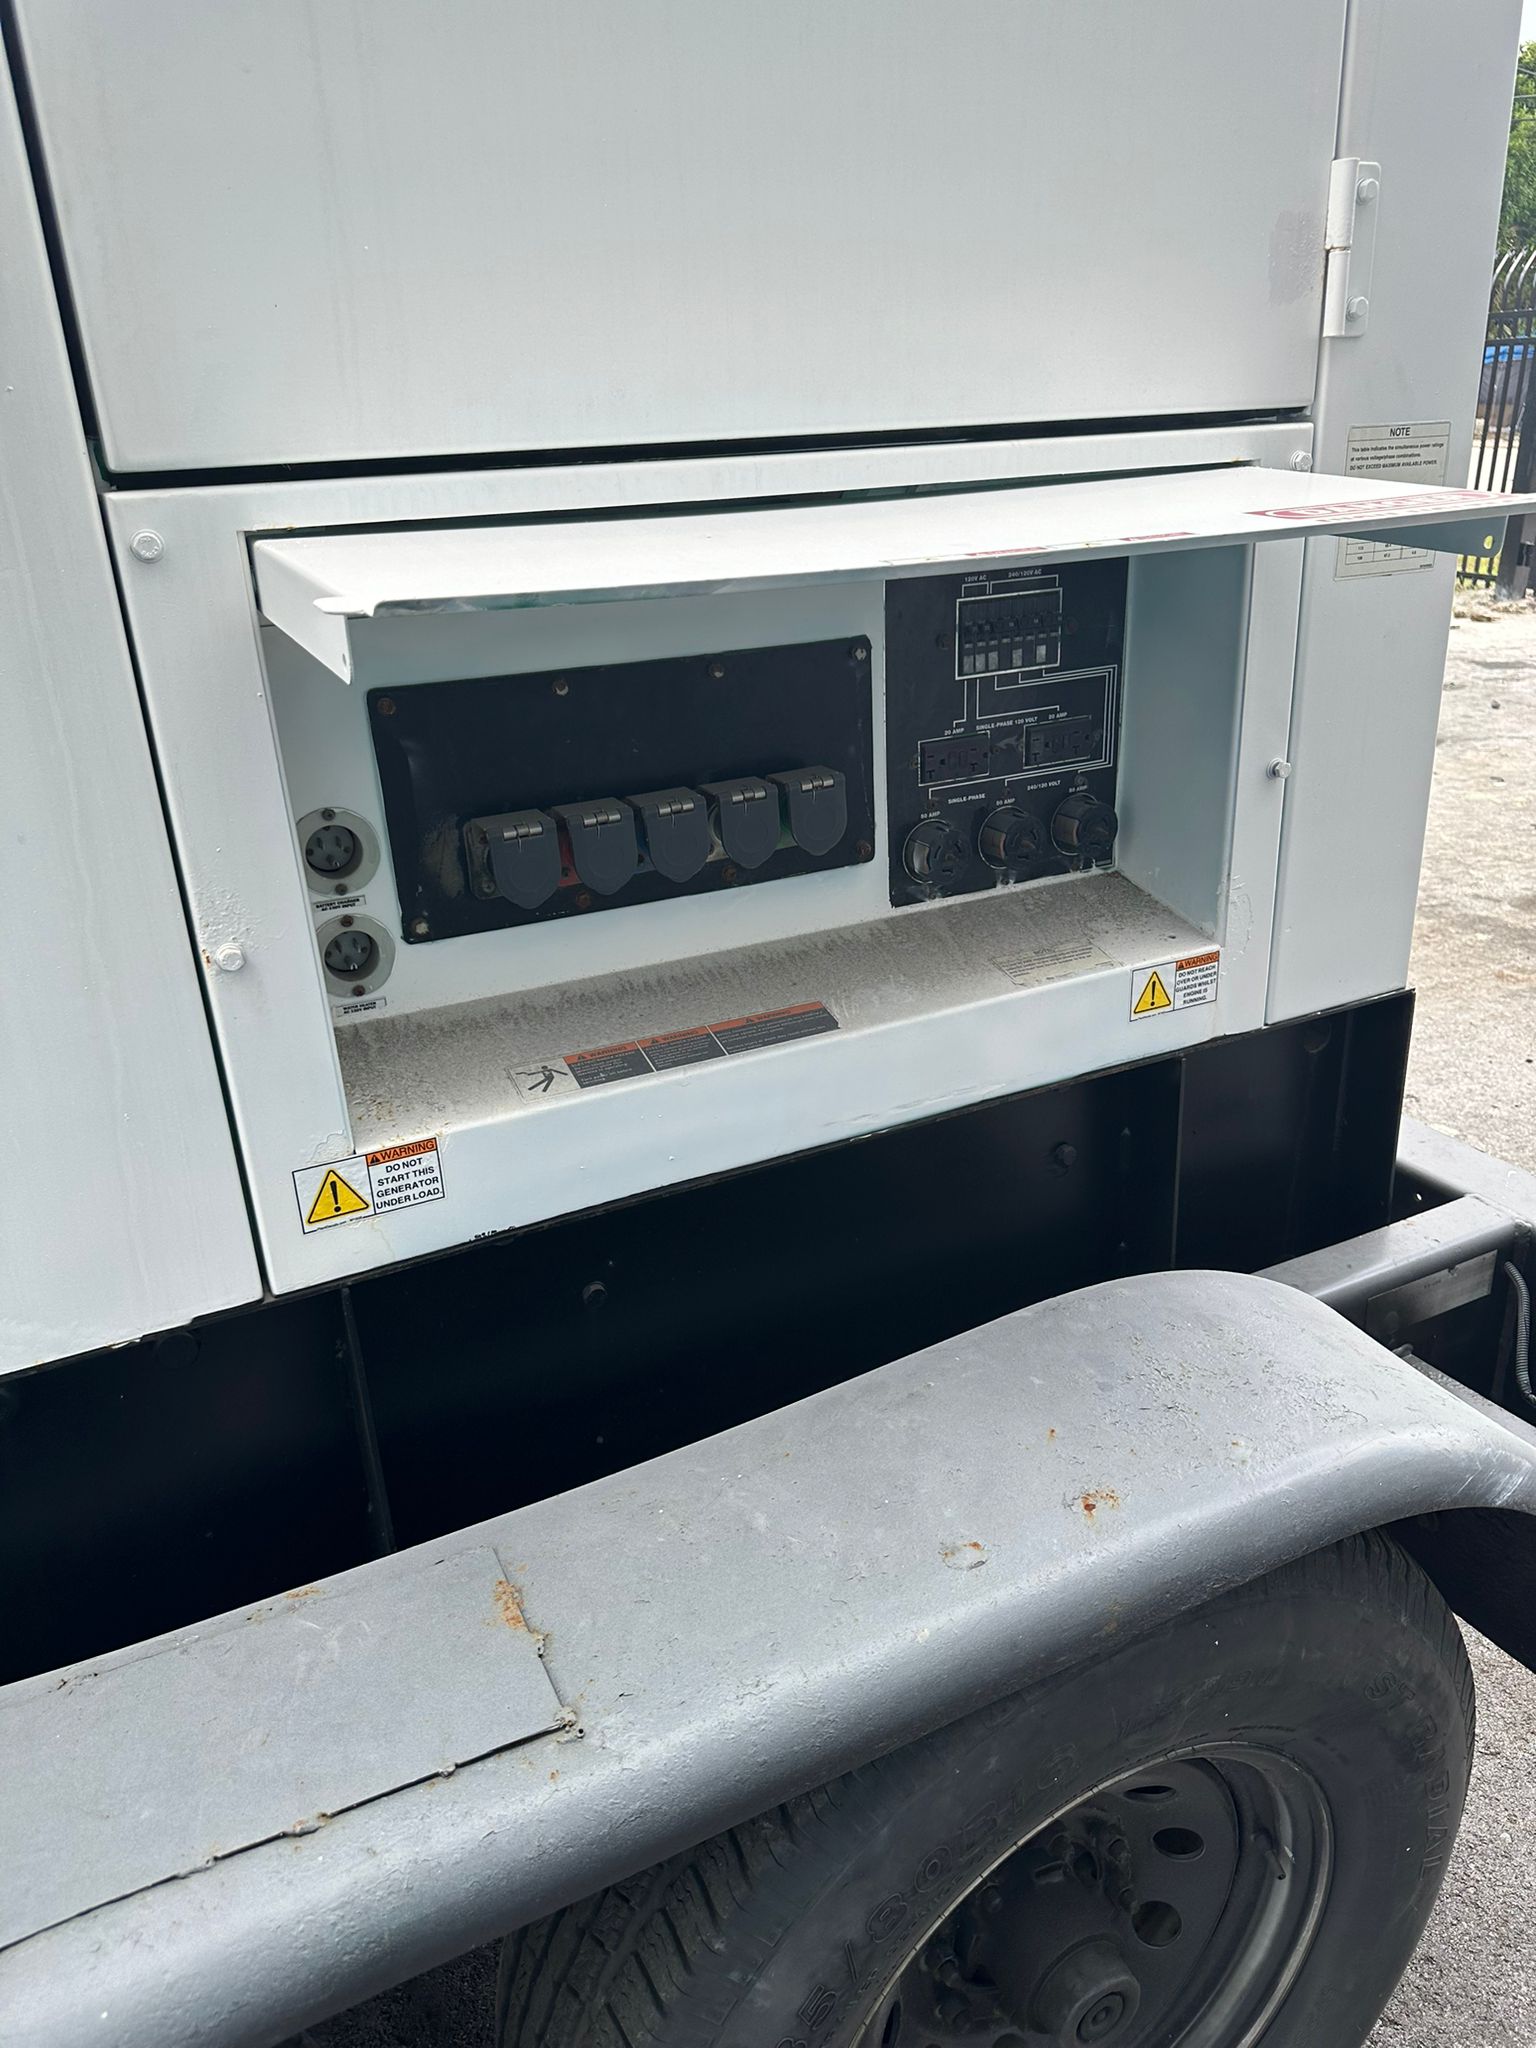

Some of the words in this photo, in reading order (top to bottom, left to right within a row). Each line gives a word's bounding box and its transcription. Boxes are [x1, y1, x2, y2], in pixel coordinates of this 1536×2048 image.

[1389, 427, 1411, 437] NOTE
[964, 575, 978, 583] 120V
[1008, 569, 1034, 578] 240/120V
[975, 720, 1013, 731] SINGLE-PHASE
[1024, 716, 1038, 724] VOLT
[1048, 779, 1061, 788] VOLT
[948, 793, 986, 804] SINGLE-PHASE
[1003, 797, 1016, 805] AMP
[928, 810, 941, 818] AMP
[1184, 953, 1218, 967] WARNING
[1198, 964, 1216, 974] REACH
[1176, 977, 1191, 986] OVER
[1199, 971, 1217, 980] UNDER
[1175, 983, 1197, 993] GUARDS
[1198, 978, 1216, 987] WHILST
[1183, 989, 1202, 998] ENGINE
[758, 1009, 791, 1021] WARNING
[591, 1045, 627, 1058] WARNING
[380, 1140, 435, 1161] WARNING
[385, 1163, 401, 1173] DO
[402, 1157, 423, 1170] NOT
[377, 1171, 412, 1187] START
[413, 1166, 435, 1179] THIS
[376, 1176, 440, 1198] GENERATOR
[376, 1193, 412, 1210] UNDER
